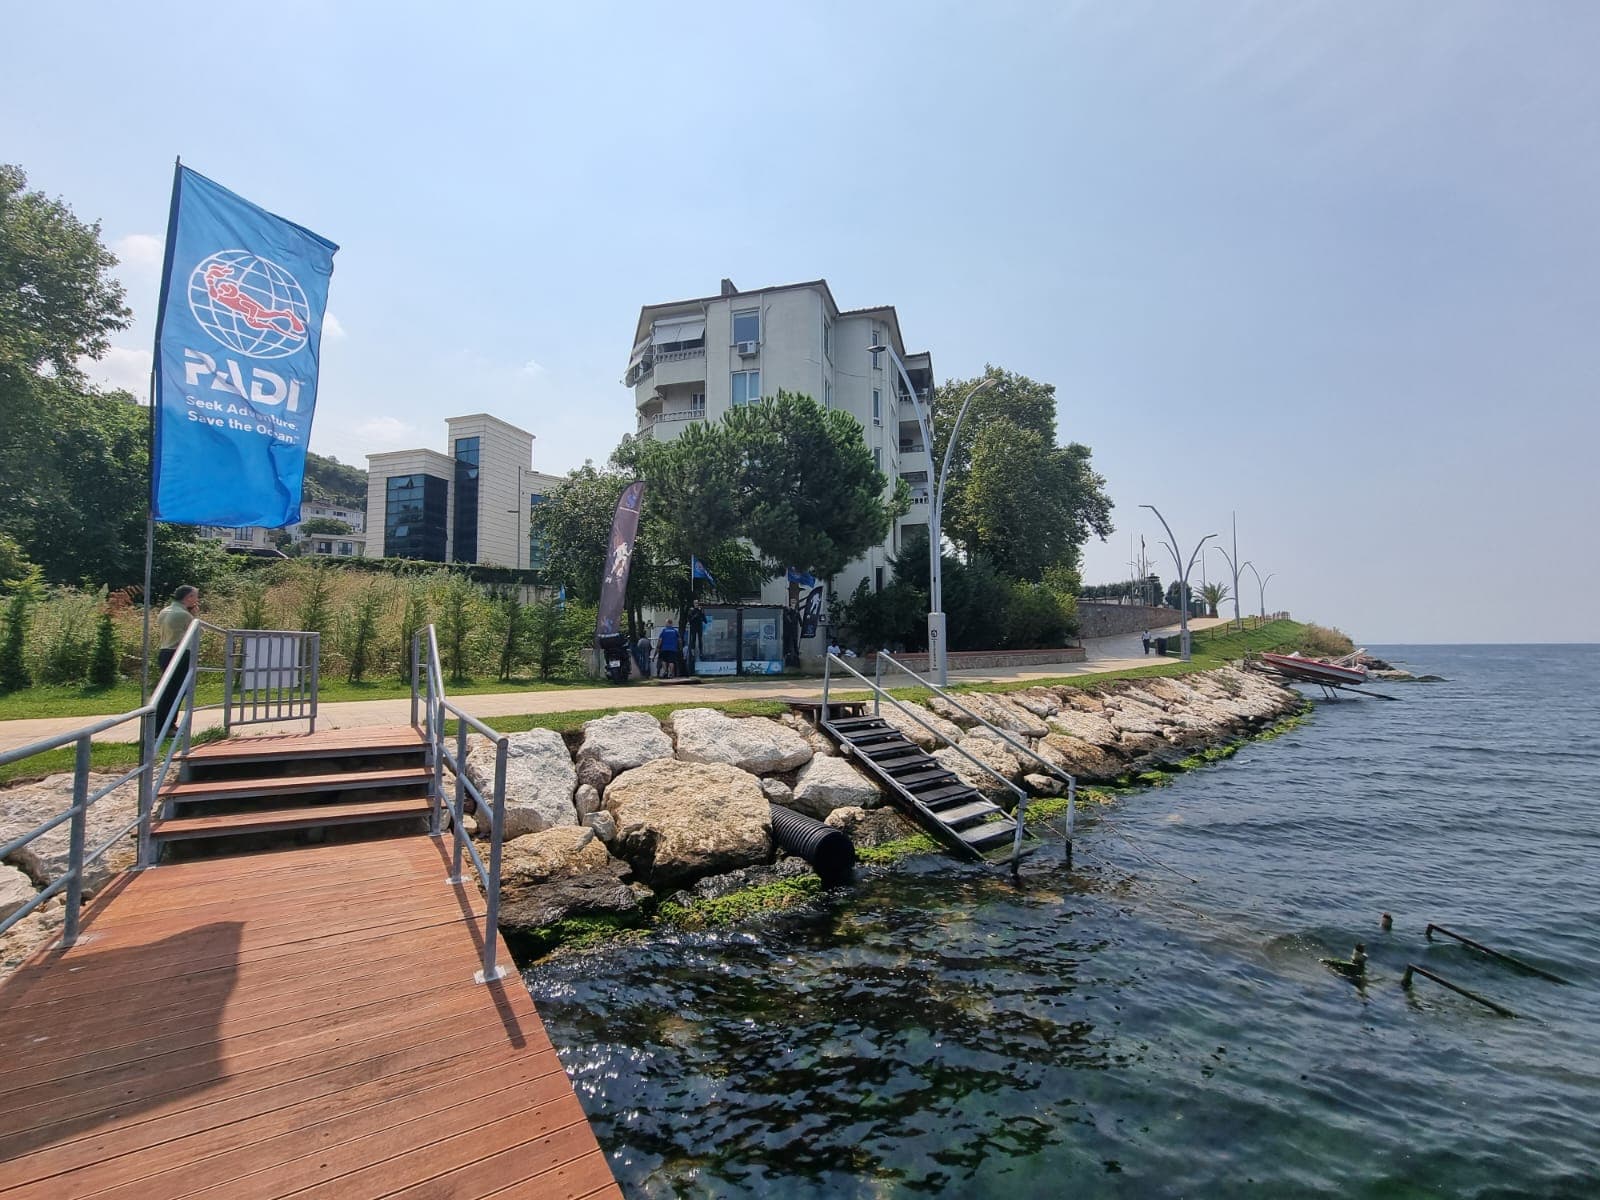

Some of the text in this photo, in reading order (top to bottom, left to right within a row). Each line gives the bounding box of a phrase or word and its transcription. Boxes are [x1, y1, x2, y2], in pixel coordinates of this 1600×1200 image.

[184, 348, 303, 412] PADI
[186, 395, 223, 412] Seek
[187, 410, 224, 427] Save
[229, 418, 252, 432] the
